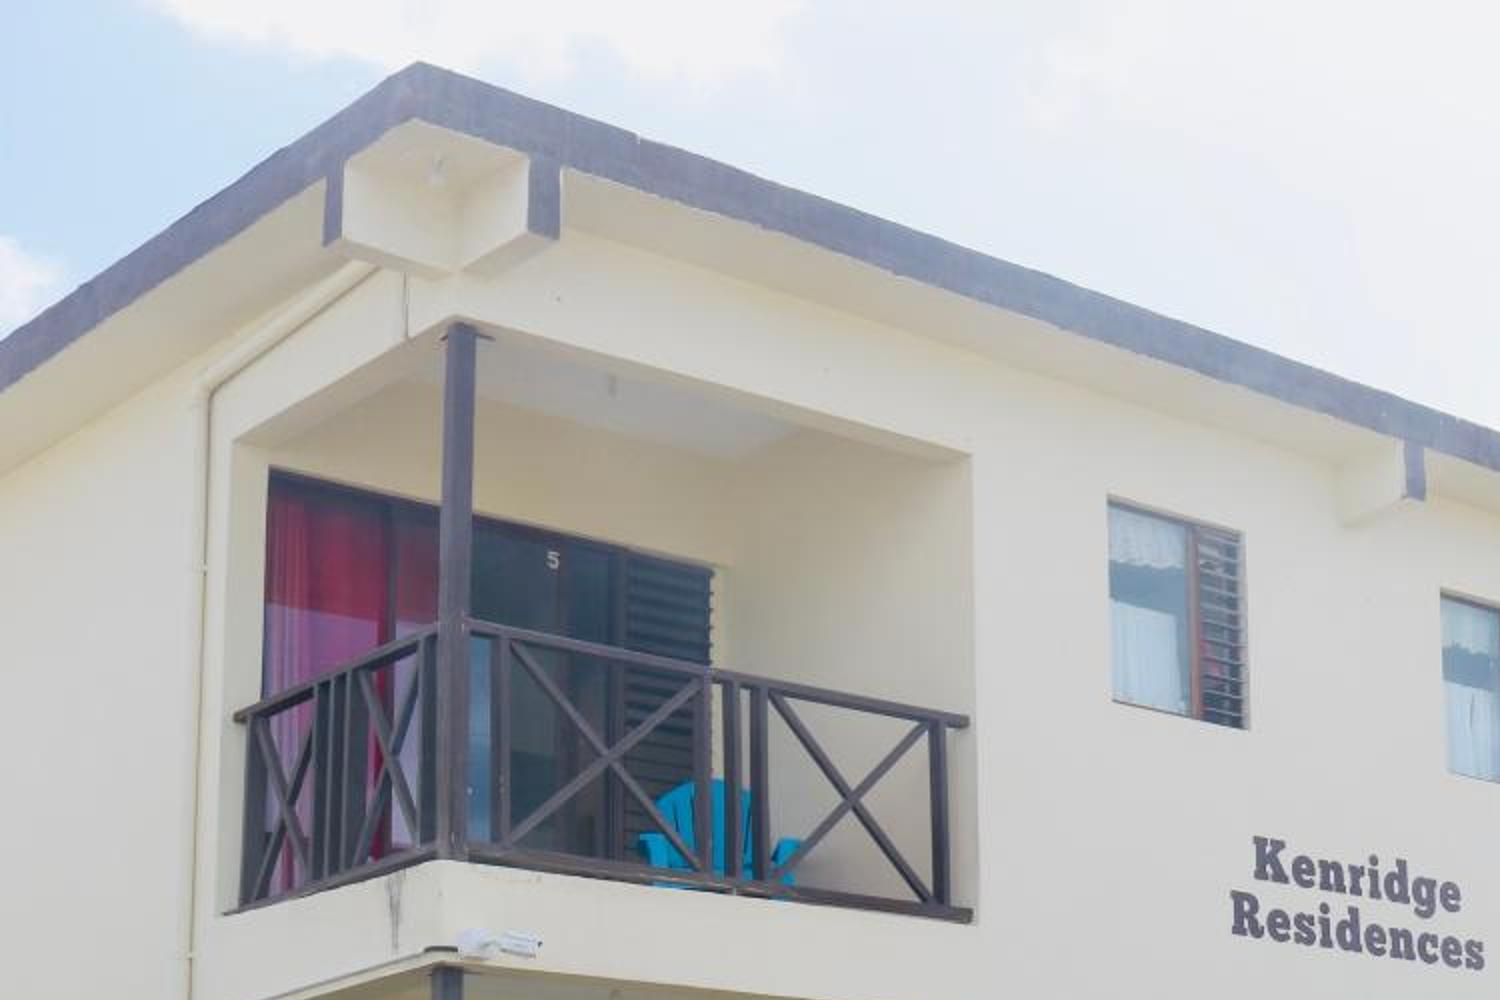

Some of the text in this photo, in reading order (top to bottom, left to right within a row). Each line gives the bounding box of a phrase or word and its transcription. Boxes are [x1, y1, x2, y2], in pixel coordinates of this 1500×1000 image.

[547, 551, 560, 569] 5
[1252, 835, 1462, 919] Kenridge
[1230, 889, 1486, 971] Residences
